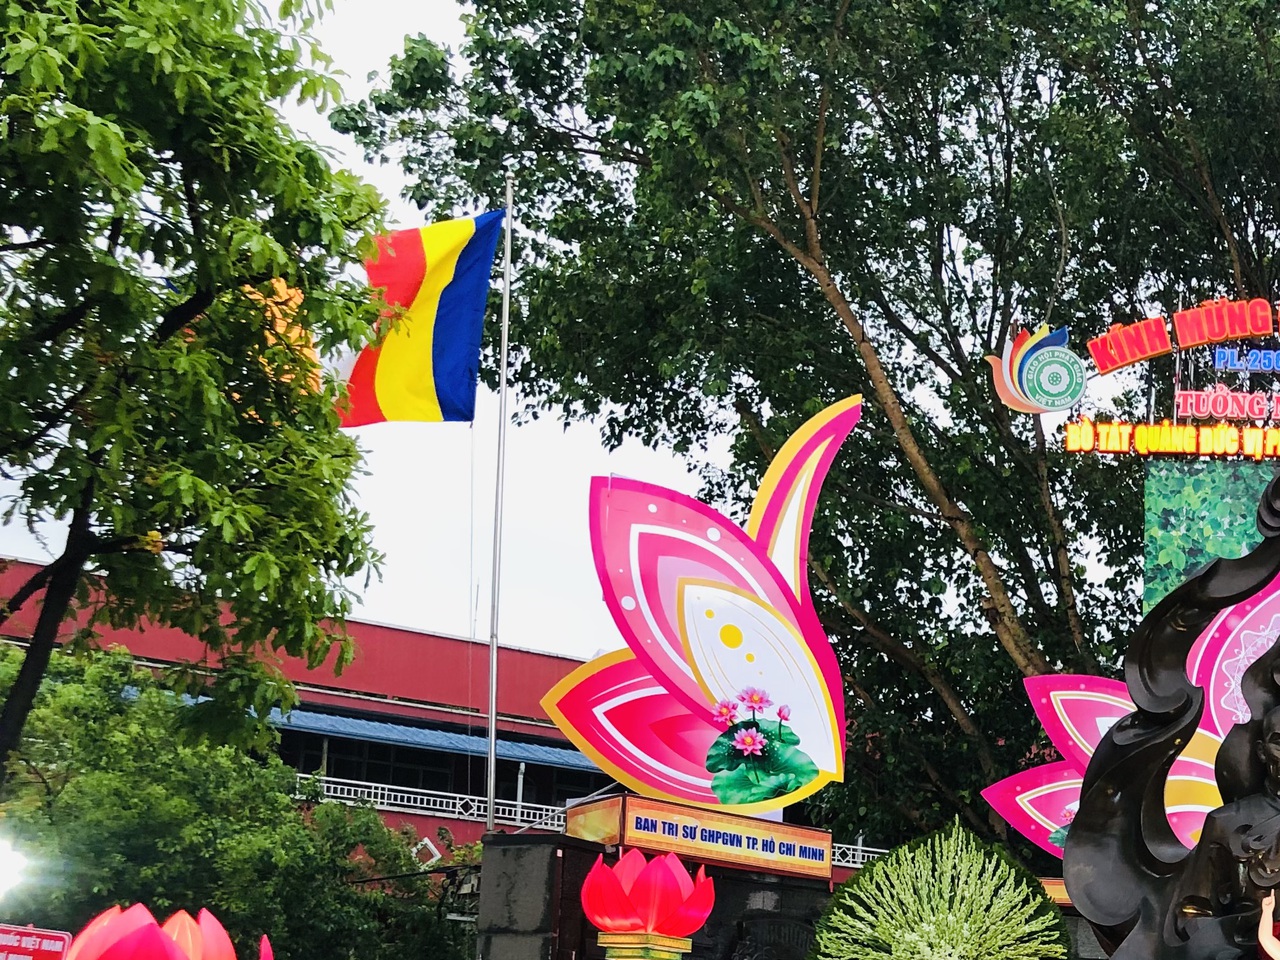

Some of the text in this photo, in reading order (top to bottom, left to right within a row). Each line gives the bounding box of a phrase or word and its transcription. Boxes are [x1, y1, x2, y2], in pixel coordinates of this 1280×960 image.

[1087, 316, 1173, 375] KÍNH
[1173, 296, 1274, 350] MỪNG
[1027, 361, 1039, 380] GIÁO
[1055, 396, 1072, 406] NAM
[1175, 383, 1268, 420] TƯỞNG
[1134, 418, 1198, 455] QUẢNG
[1242, 427, 1264, 461] VỊ
[635, 816, 825, 862] BAN TRỊ SỰ GHPGVN TP. HỒ CHÍ MINH
